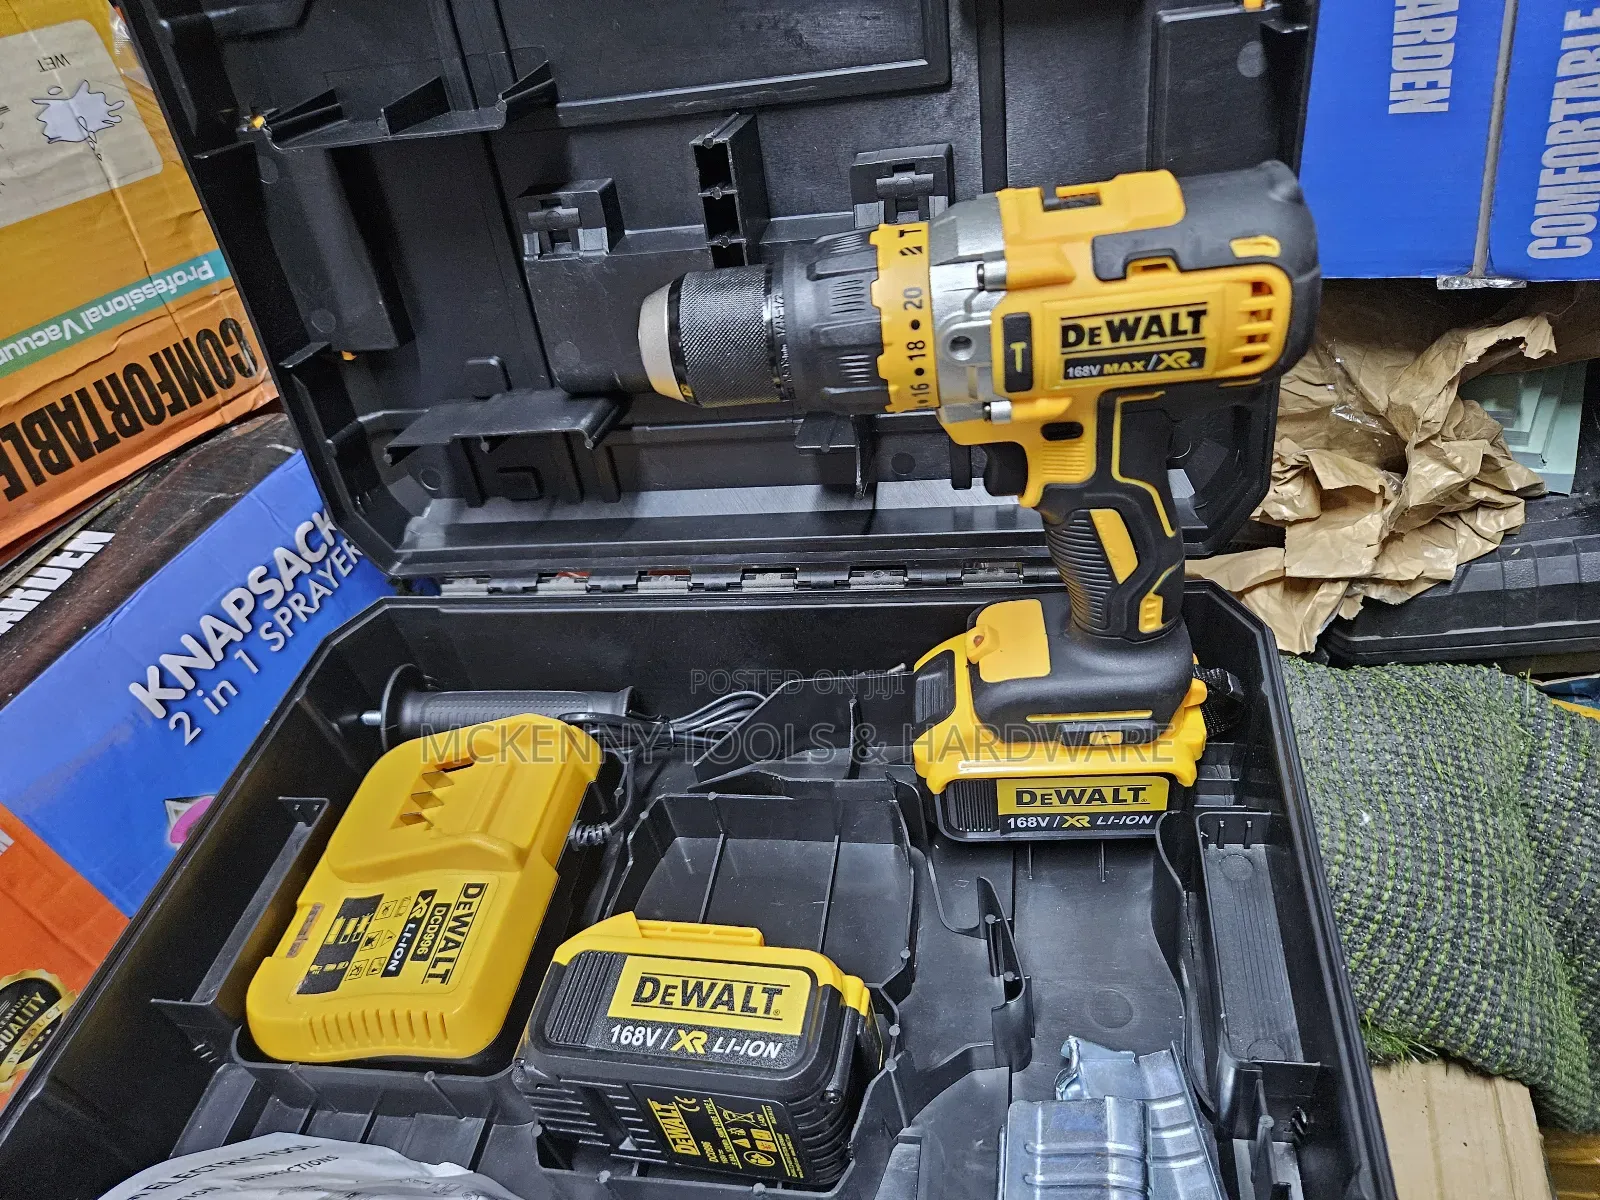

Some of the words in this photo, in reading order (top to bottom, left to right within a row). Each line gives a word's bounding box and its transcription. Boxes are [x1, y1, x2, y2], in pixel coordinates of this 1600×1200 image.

[37, 53, 70, 73] WET
[79, 260, 216, 332] Professional
[904, 287, 924, 311] 20
[1062, 309, 1207, 348] DEWALT
[906, 340, 927, 361] 18
[910, 383, 930, 397] 16
[1067, 366, 1100, 377] 168V
[129, 507, 337, 719] KNAPSACK
[168, 711, 202, 746] 2
[197, 678, 239, 715] in
[234, 649, 259, 674] 1
[259, 538, 363, 652] SPRAYER
[1016, 787, 1146, 805] DEWALT
[1096, 815, 1153, 825] LI-ION
[409, 896, 433, 919] XR
[387, 923, 416, 971] LI-ION
[416, 906, 447, 955] DCD996
[427, 883, 487, 984] DEWALT
[632, 976, 783, 1016] DEWALT
[8, 1006, 61, 1063] PRODUCT
[711, 1037, 783, 1059] LI-ION
[650, 1100, 697, 1155] DEWALT
